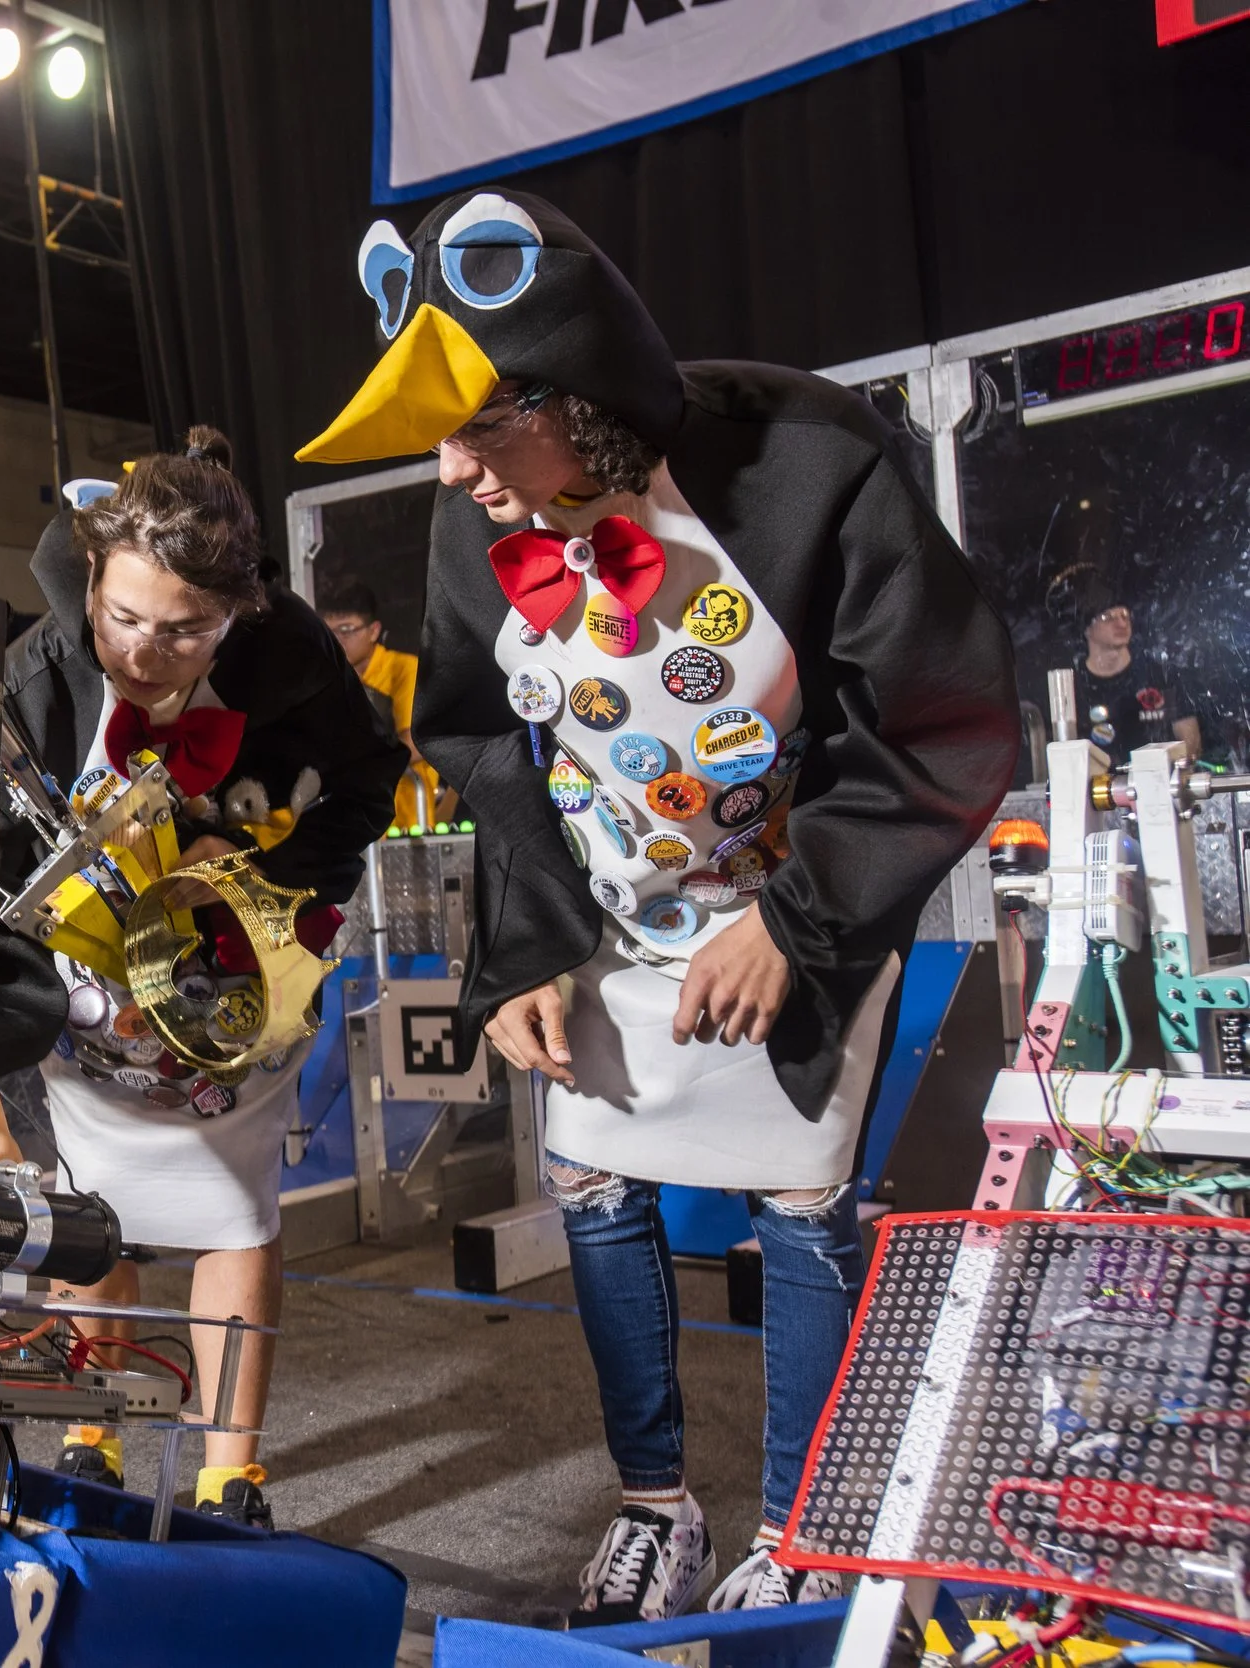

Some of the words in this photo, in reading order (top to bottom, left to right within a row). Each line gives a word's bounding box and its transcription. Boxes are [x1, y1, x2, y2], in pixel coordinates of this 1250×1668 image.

[588, 610, 604, 619] FIRST
[691, 621, 705, 636] 846
[678, 671, 708, 679] MENSTRUAL
[575, 691, 593, 710] 7419
[713, 712, 743, 726] 6238
[705, 729, 748, 755] CHARGED
[748, 723, 761, 738] UP
[713, 761, 739, 773] DRIVE
[741, 757, 764, 768] TEAM
[79, 771, 100, 791] 6238
[109, 774, 118, 786] UP
[557, 794, 581, 809] 599
[644, 833, 681, 845] OtterBots
[735, 872, 767, 890] 8521
